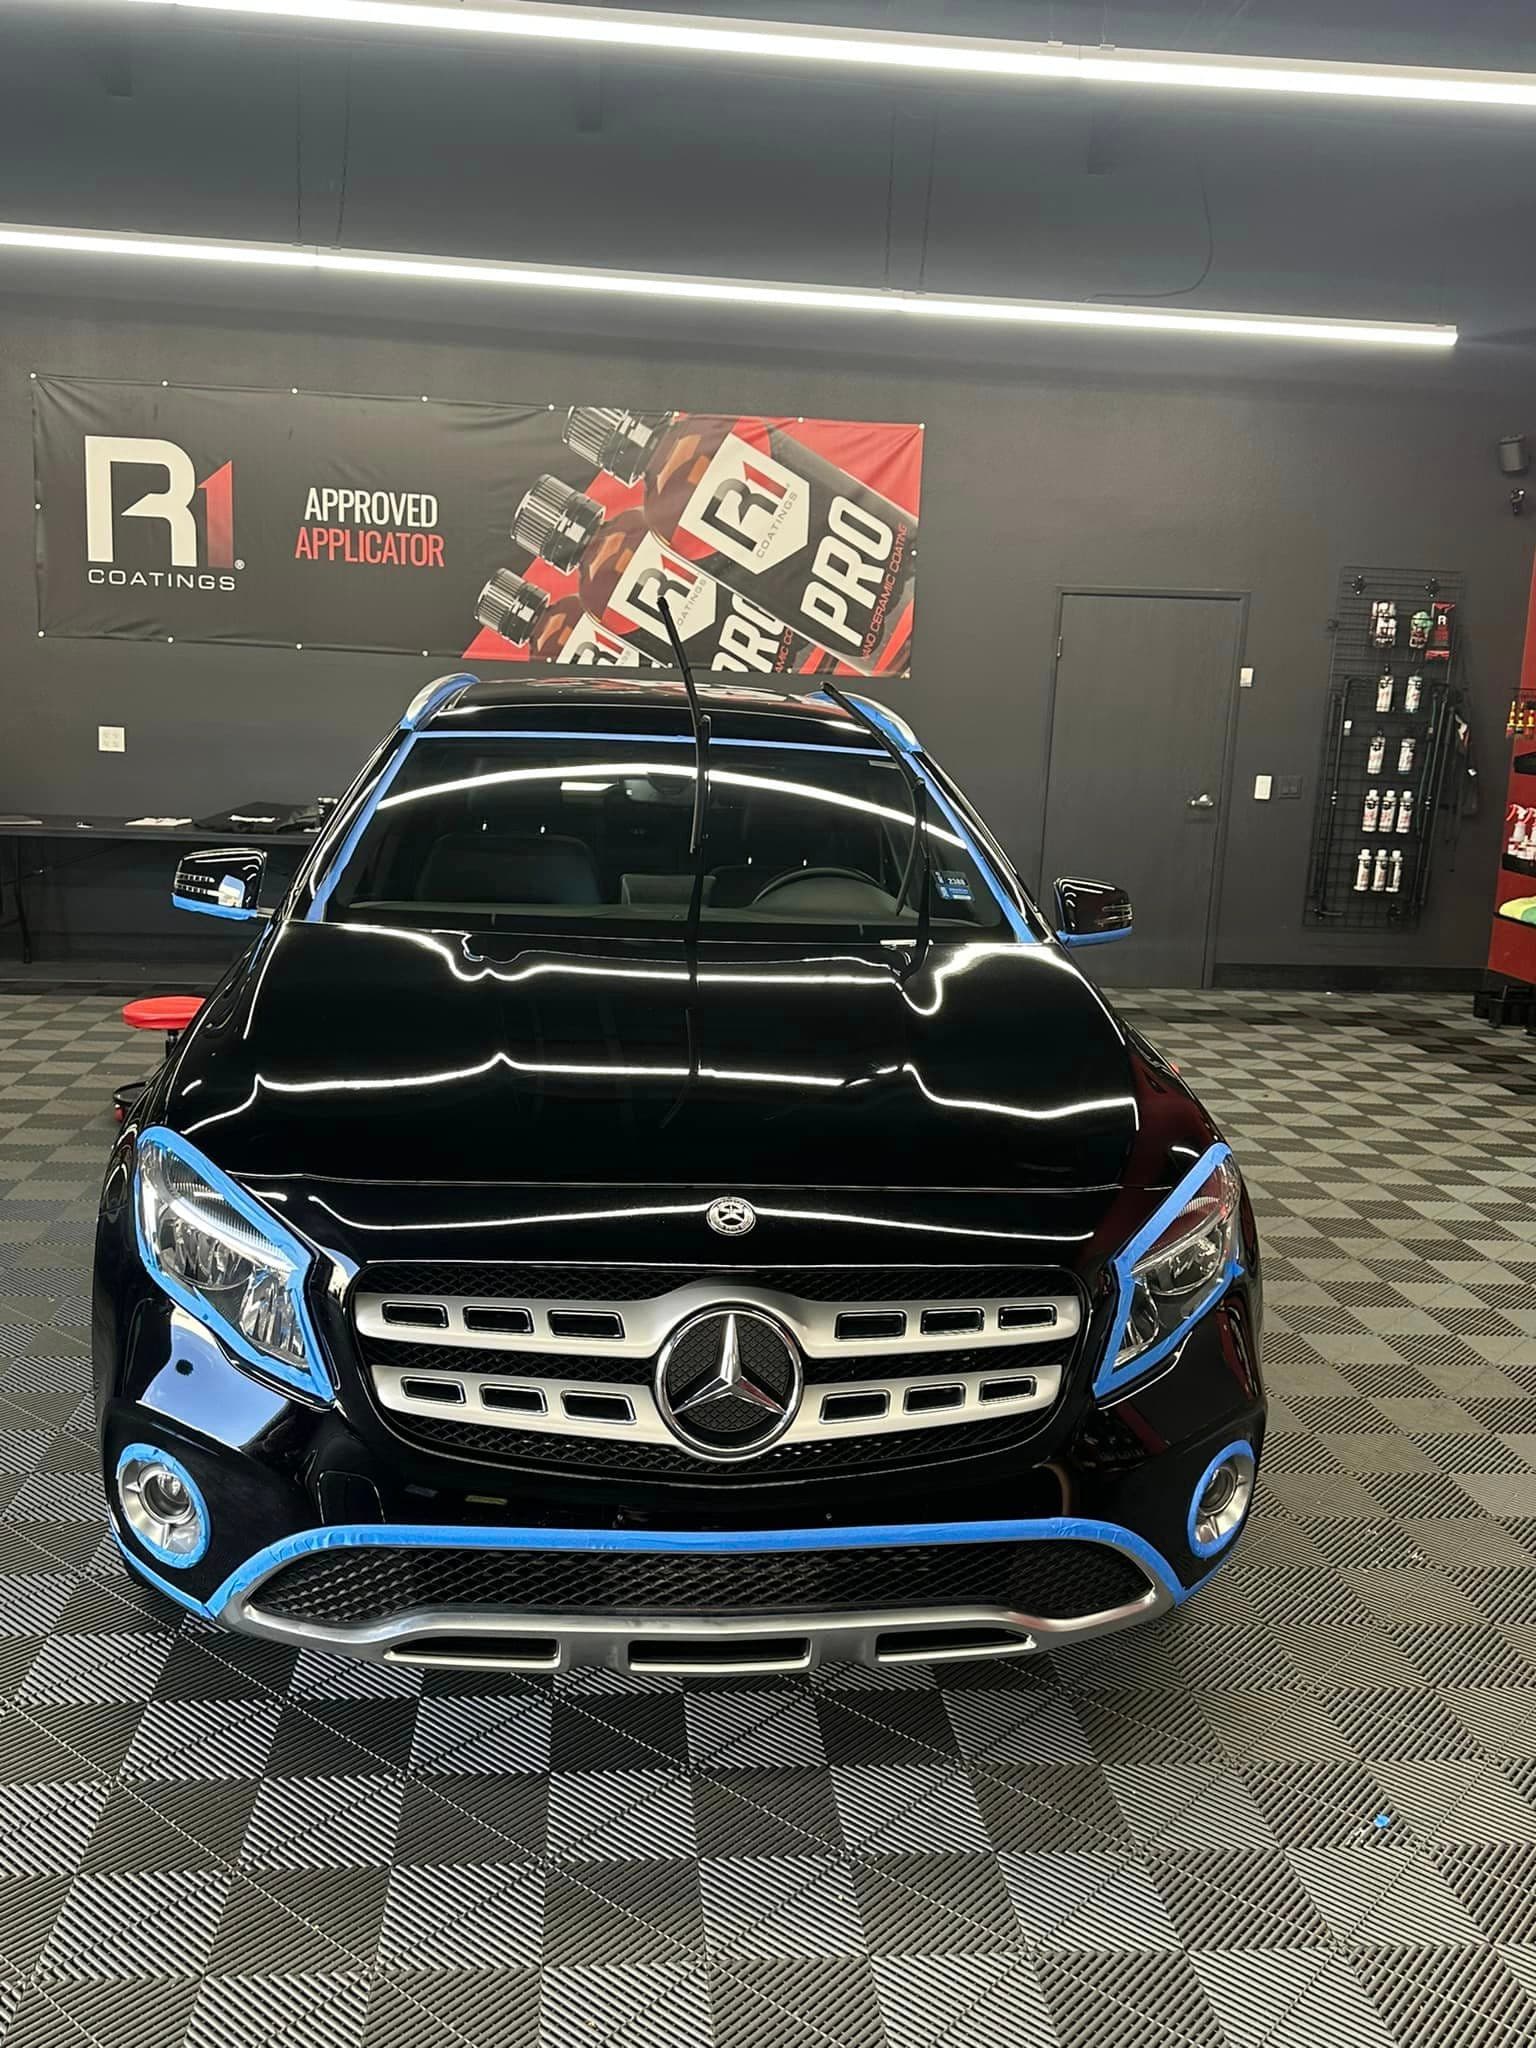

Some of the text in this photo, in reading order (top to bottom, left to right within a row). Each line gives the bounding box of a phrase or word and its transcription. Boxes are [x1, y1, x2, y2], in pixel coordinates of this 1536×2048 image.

[85, 435, 234, 569] R1
[304, 487, 438, 528] APPROVED
[700, 461, 788, 552] R1
[756, 491, 798, 558] COATINGS
[88, 569, 236, 591] COATINGS
[295, 527, 445, 567] APPLICATOR
[800, 495, 893, 647] PRO
[870, 575, 897, 632] CERAMIC
[889, 523, 908, 573] COATING
